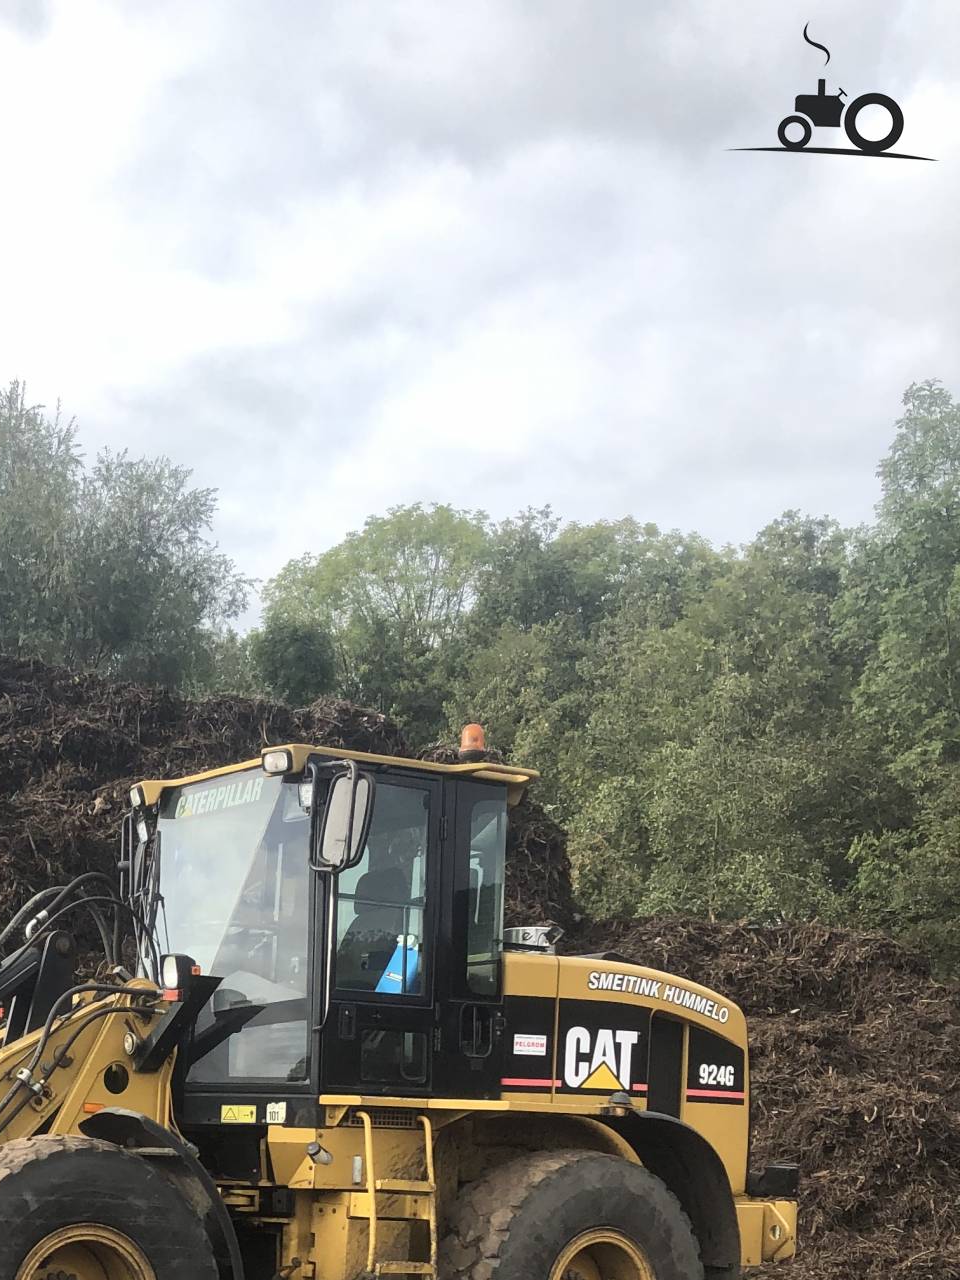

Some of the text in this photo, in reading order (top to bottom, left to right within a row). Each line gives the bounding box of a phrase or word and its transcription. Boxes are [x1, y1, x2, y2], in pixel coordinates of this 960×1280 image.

[175, 777, 264, 819] CATERPILLAR
[588, 971, 729, 1023] SMEITINK HUMMELO
[564, 1026, 638, 1090] CAT
[699, 1064, 735, 1087] 924G
